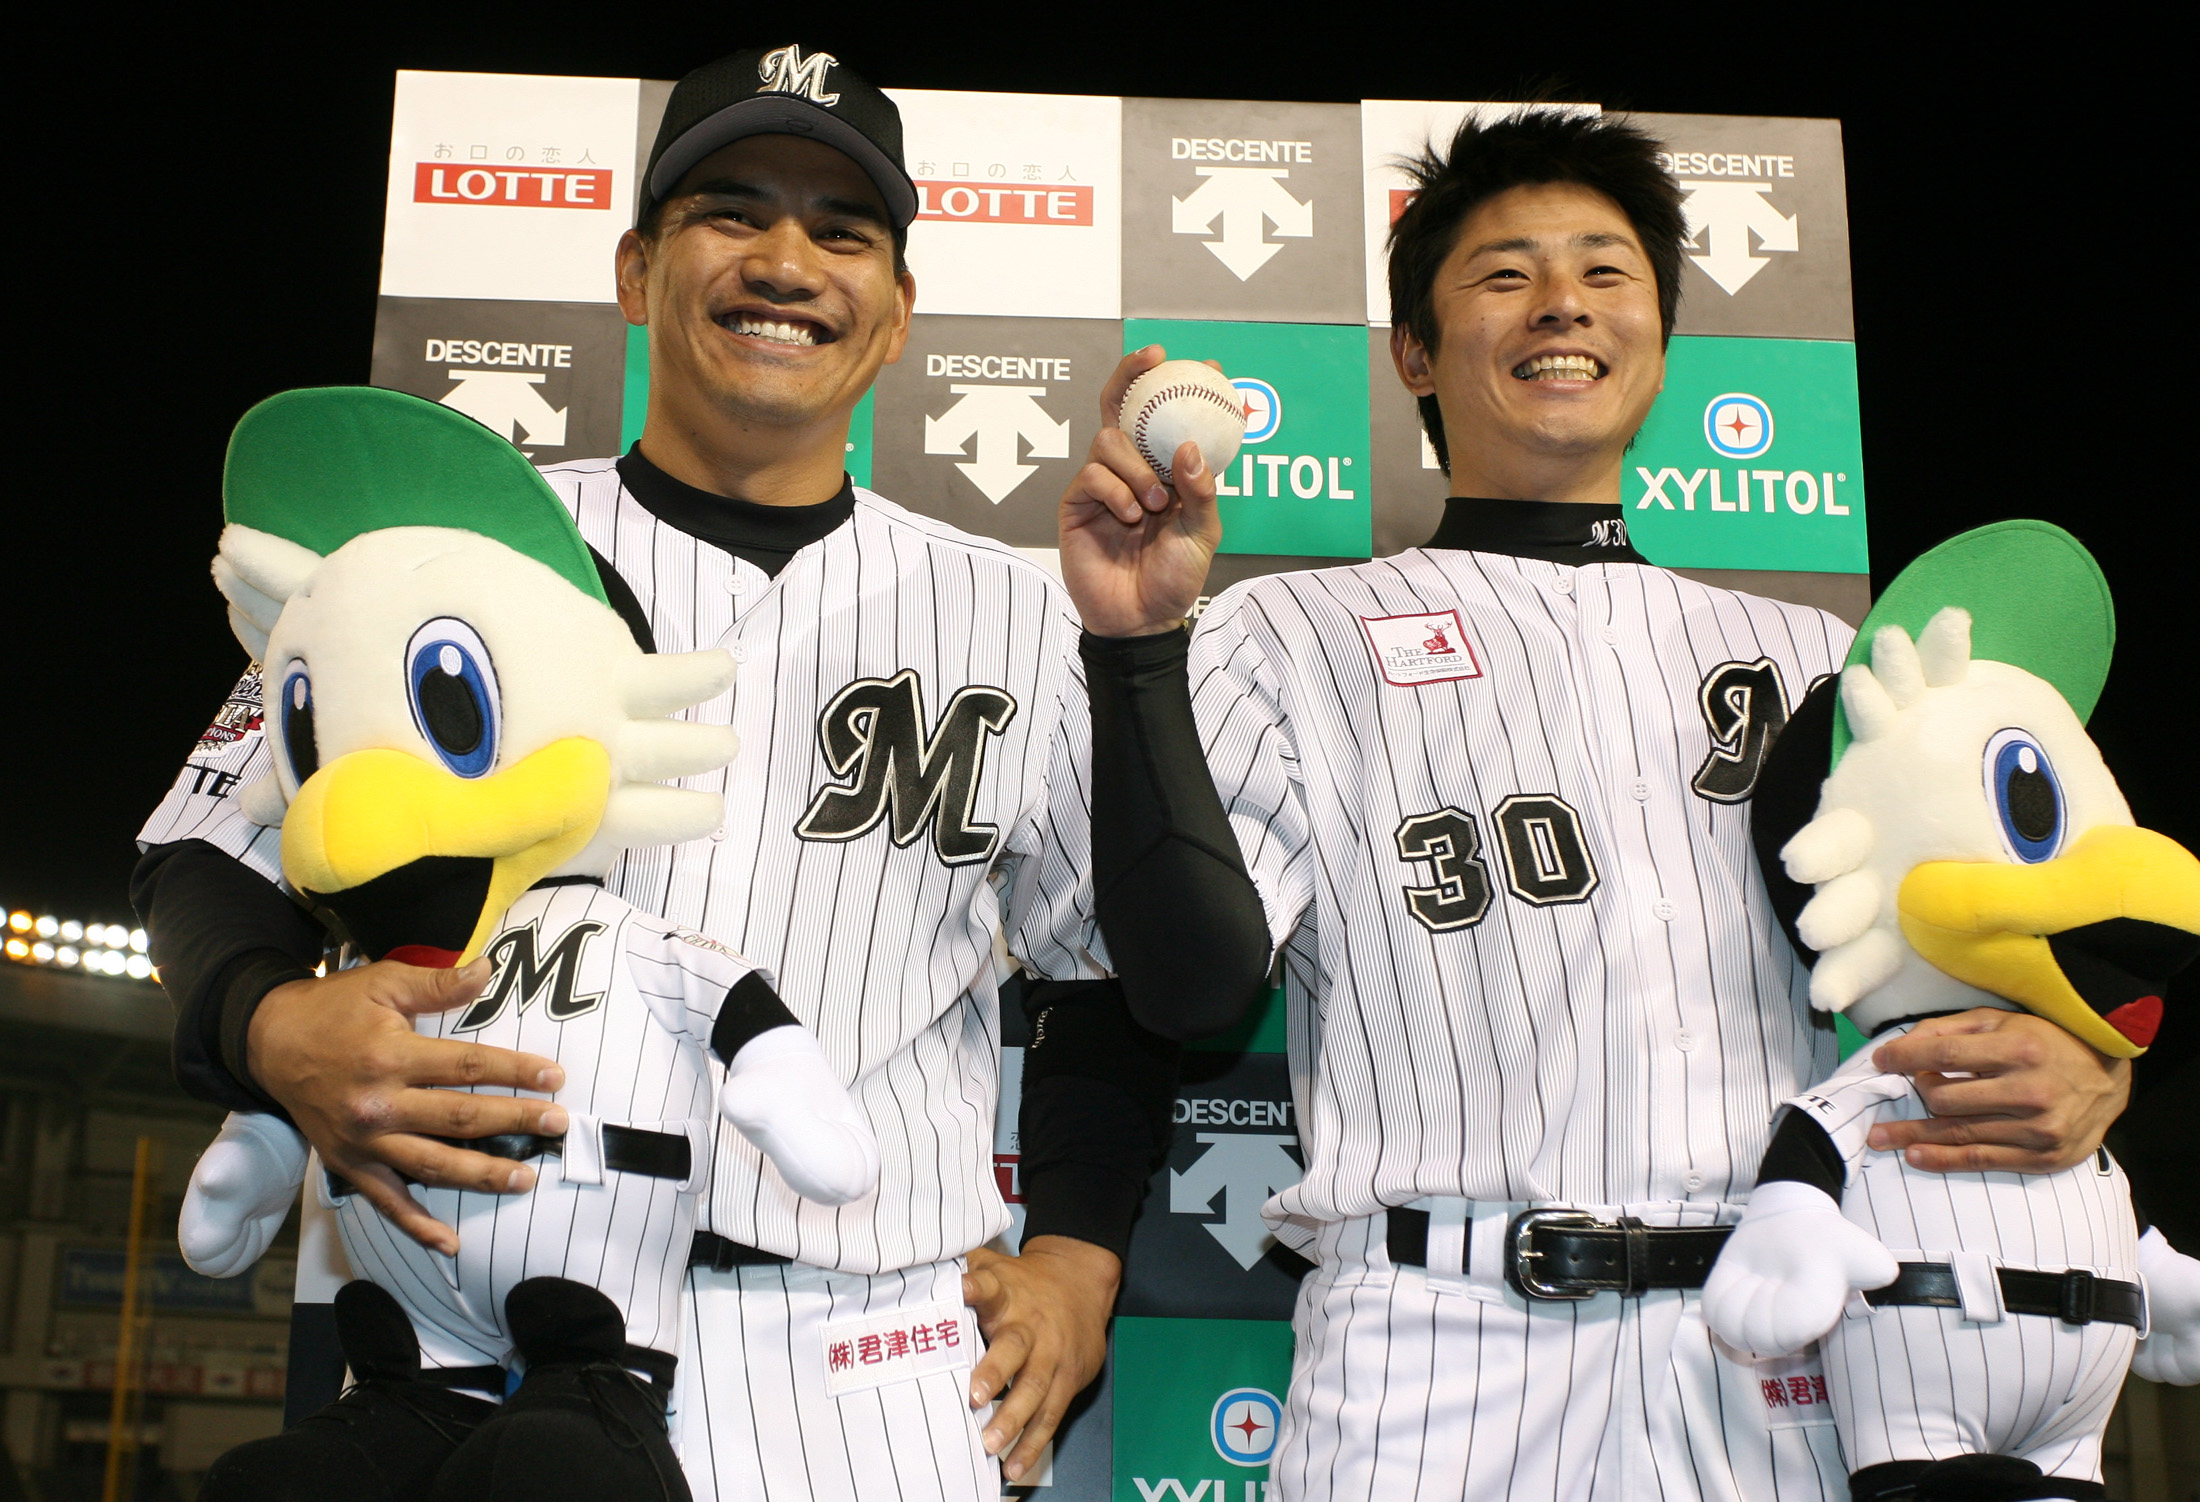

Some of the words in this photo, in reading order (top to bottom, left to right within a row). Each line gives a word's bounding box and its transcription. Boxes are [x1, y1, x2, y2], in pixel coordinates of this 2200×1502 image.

[434, 143, 596, 164] お口の恋人
[1171, 137, 1313, 164] DESCENTE
[1656, 152, 1795, 177] DESCENTE
[917, 160, 1077, 181] お口の恋人
[431, 169, 596, 203] LOTTE
[916, 186, 1077, 219] LOTTE
[425, 339, 572, 368] DESCENTE
[926, 354, 1071, 381] DESCENTE
[1385, 655, 1462, 668] HARTFORD
[793, 667, 1018, 868] M
[1393, 793, 1600, 933] 30
[451, 917, 609, 1034] M
